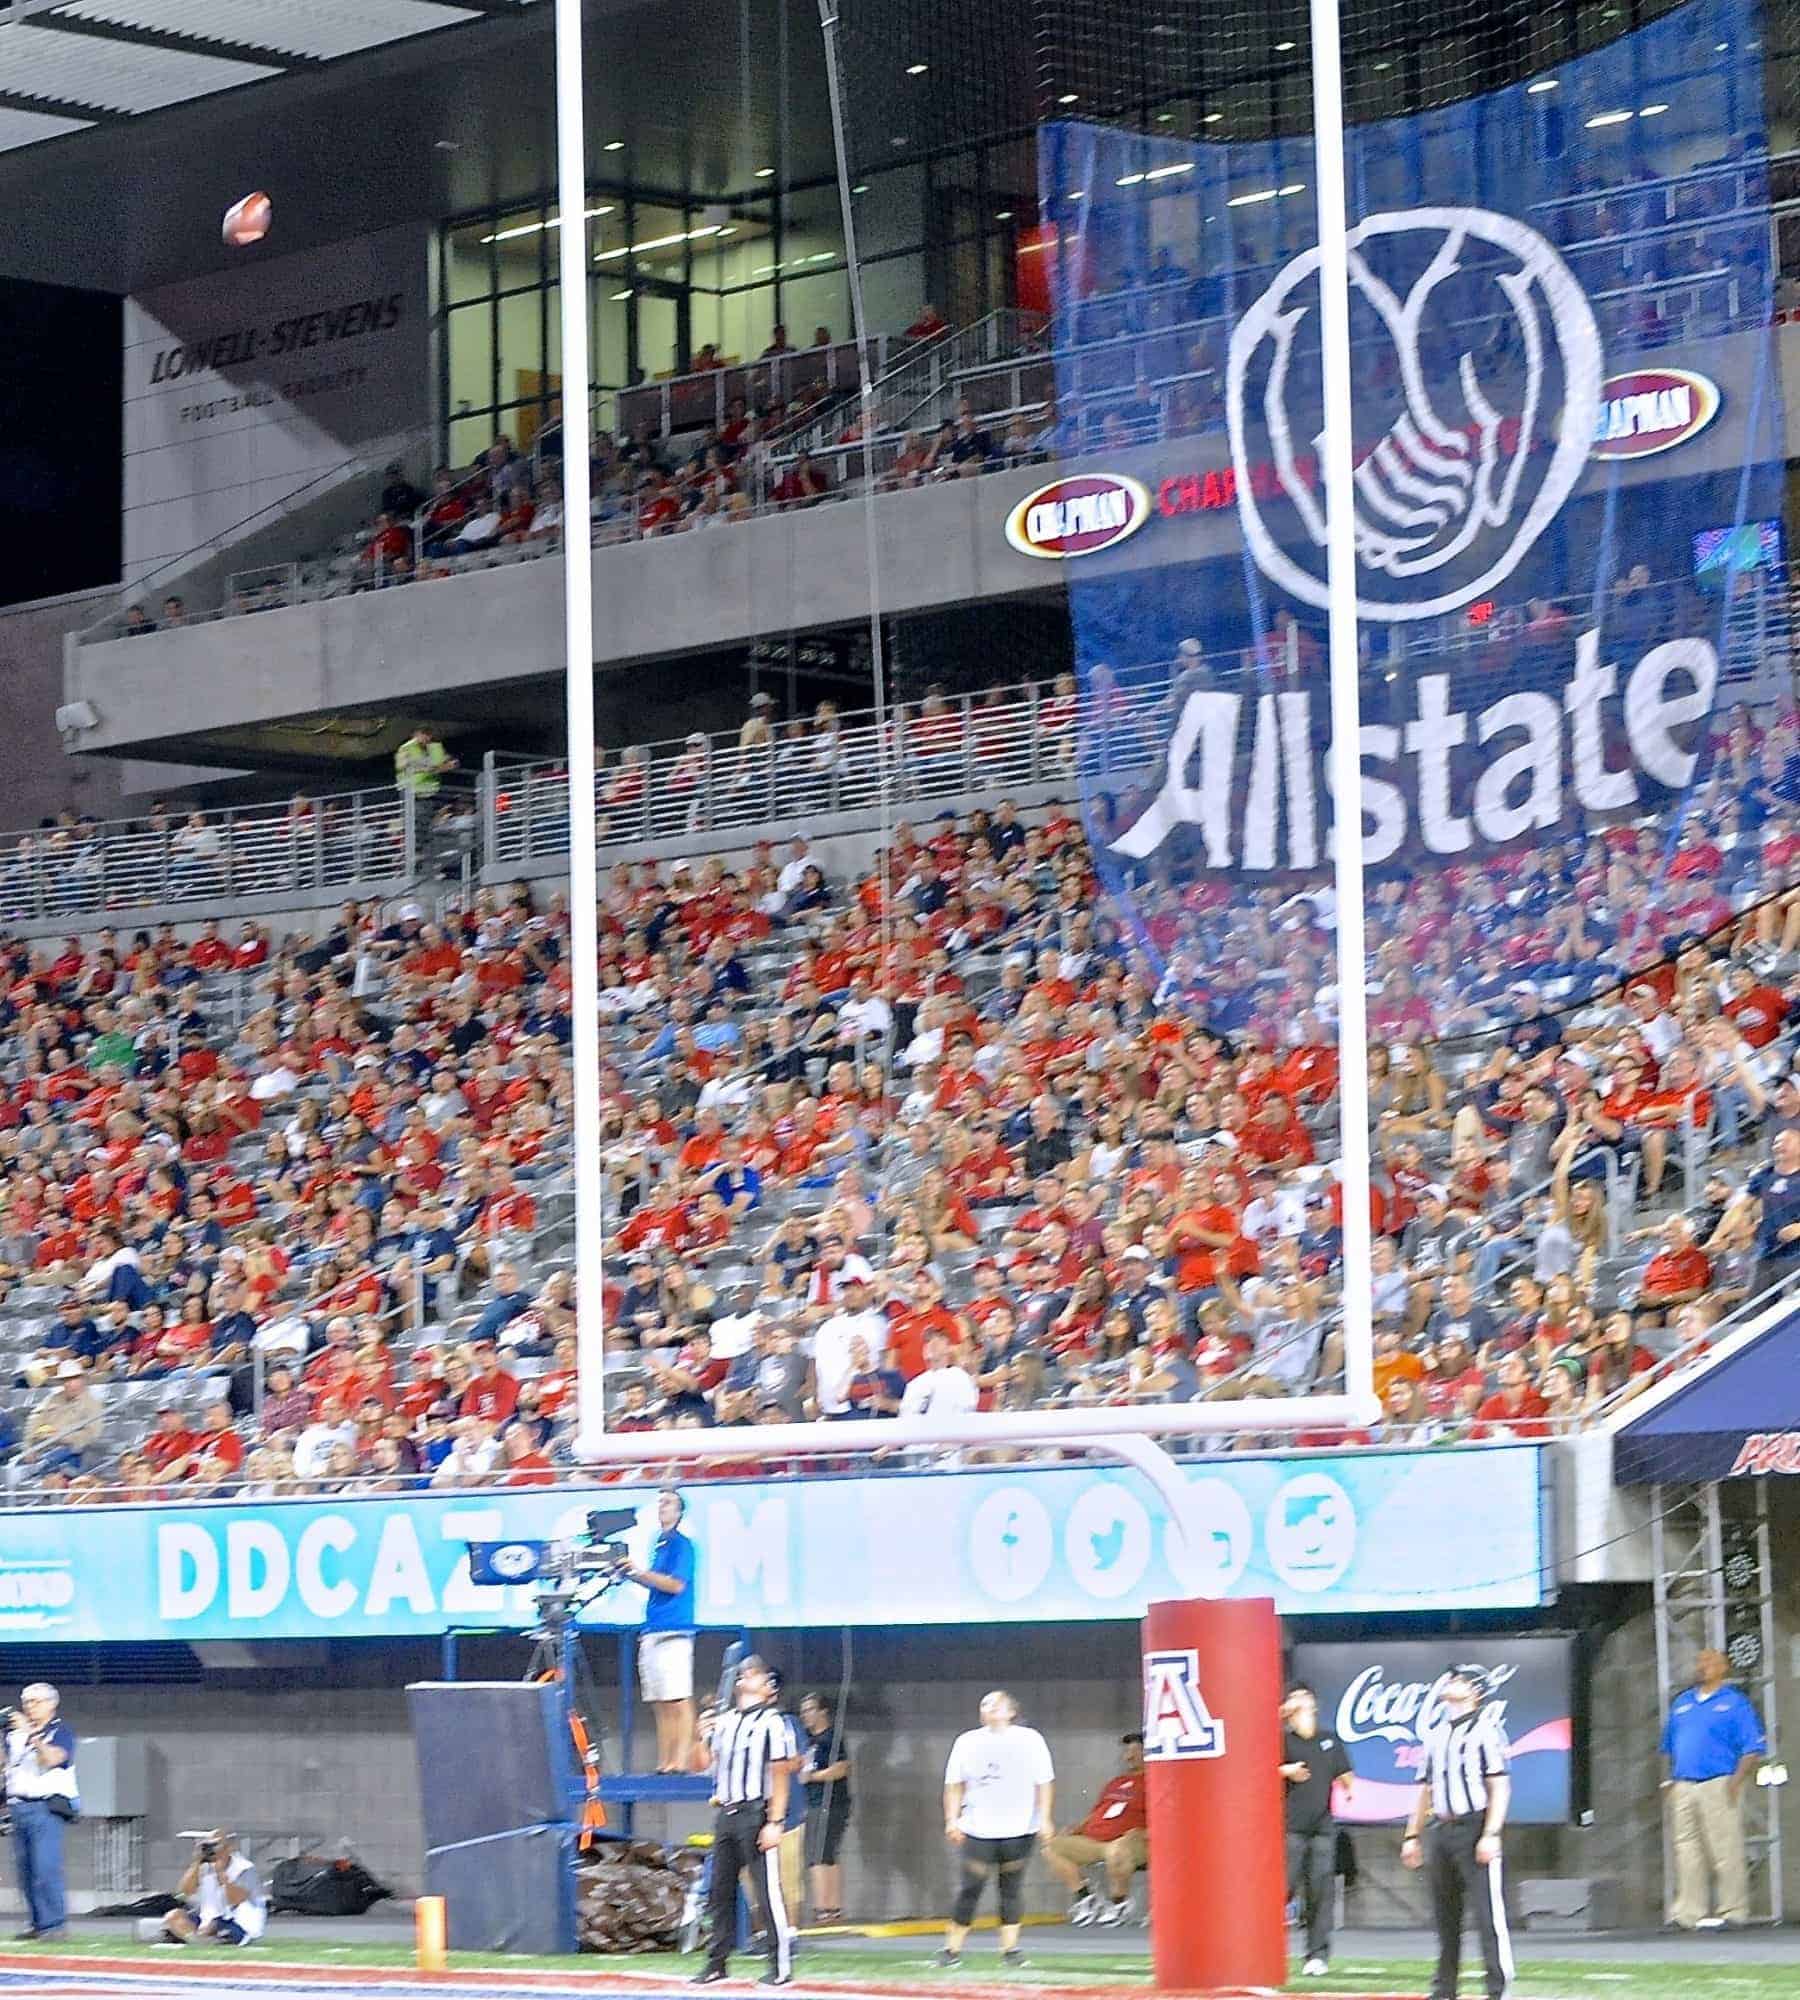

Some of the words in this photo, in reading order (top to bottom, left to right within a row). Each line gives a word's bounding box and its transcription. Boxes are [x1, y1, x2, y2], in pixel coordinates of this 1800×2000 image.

[151, 294, 402, 384] LOWELL-STEVENS
[1107, 629, 1719, 869] Allstate
[1142, 1649, 1226, 1762] A
